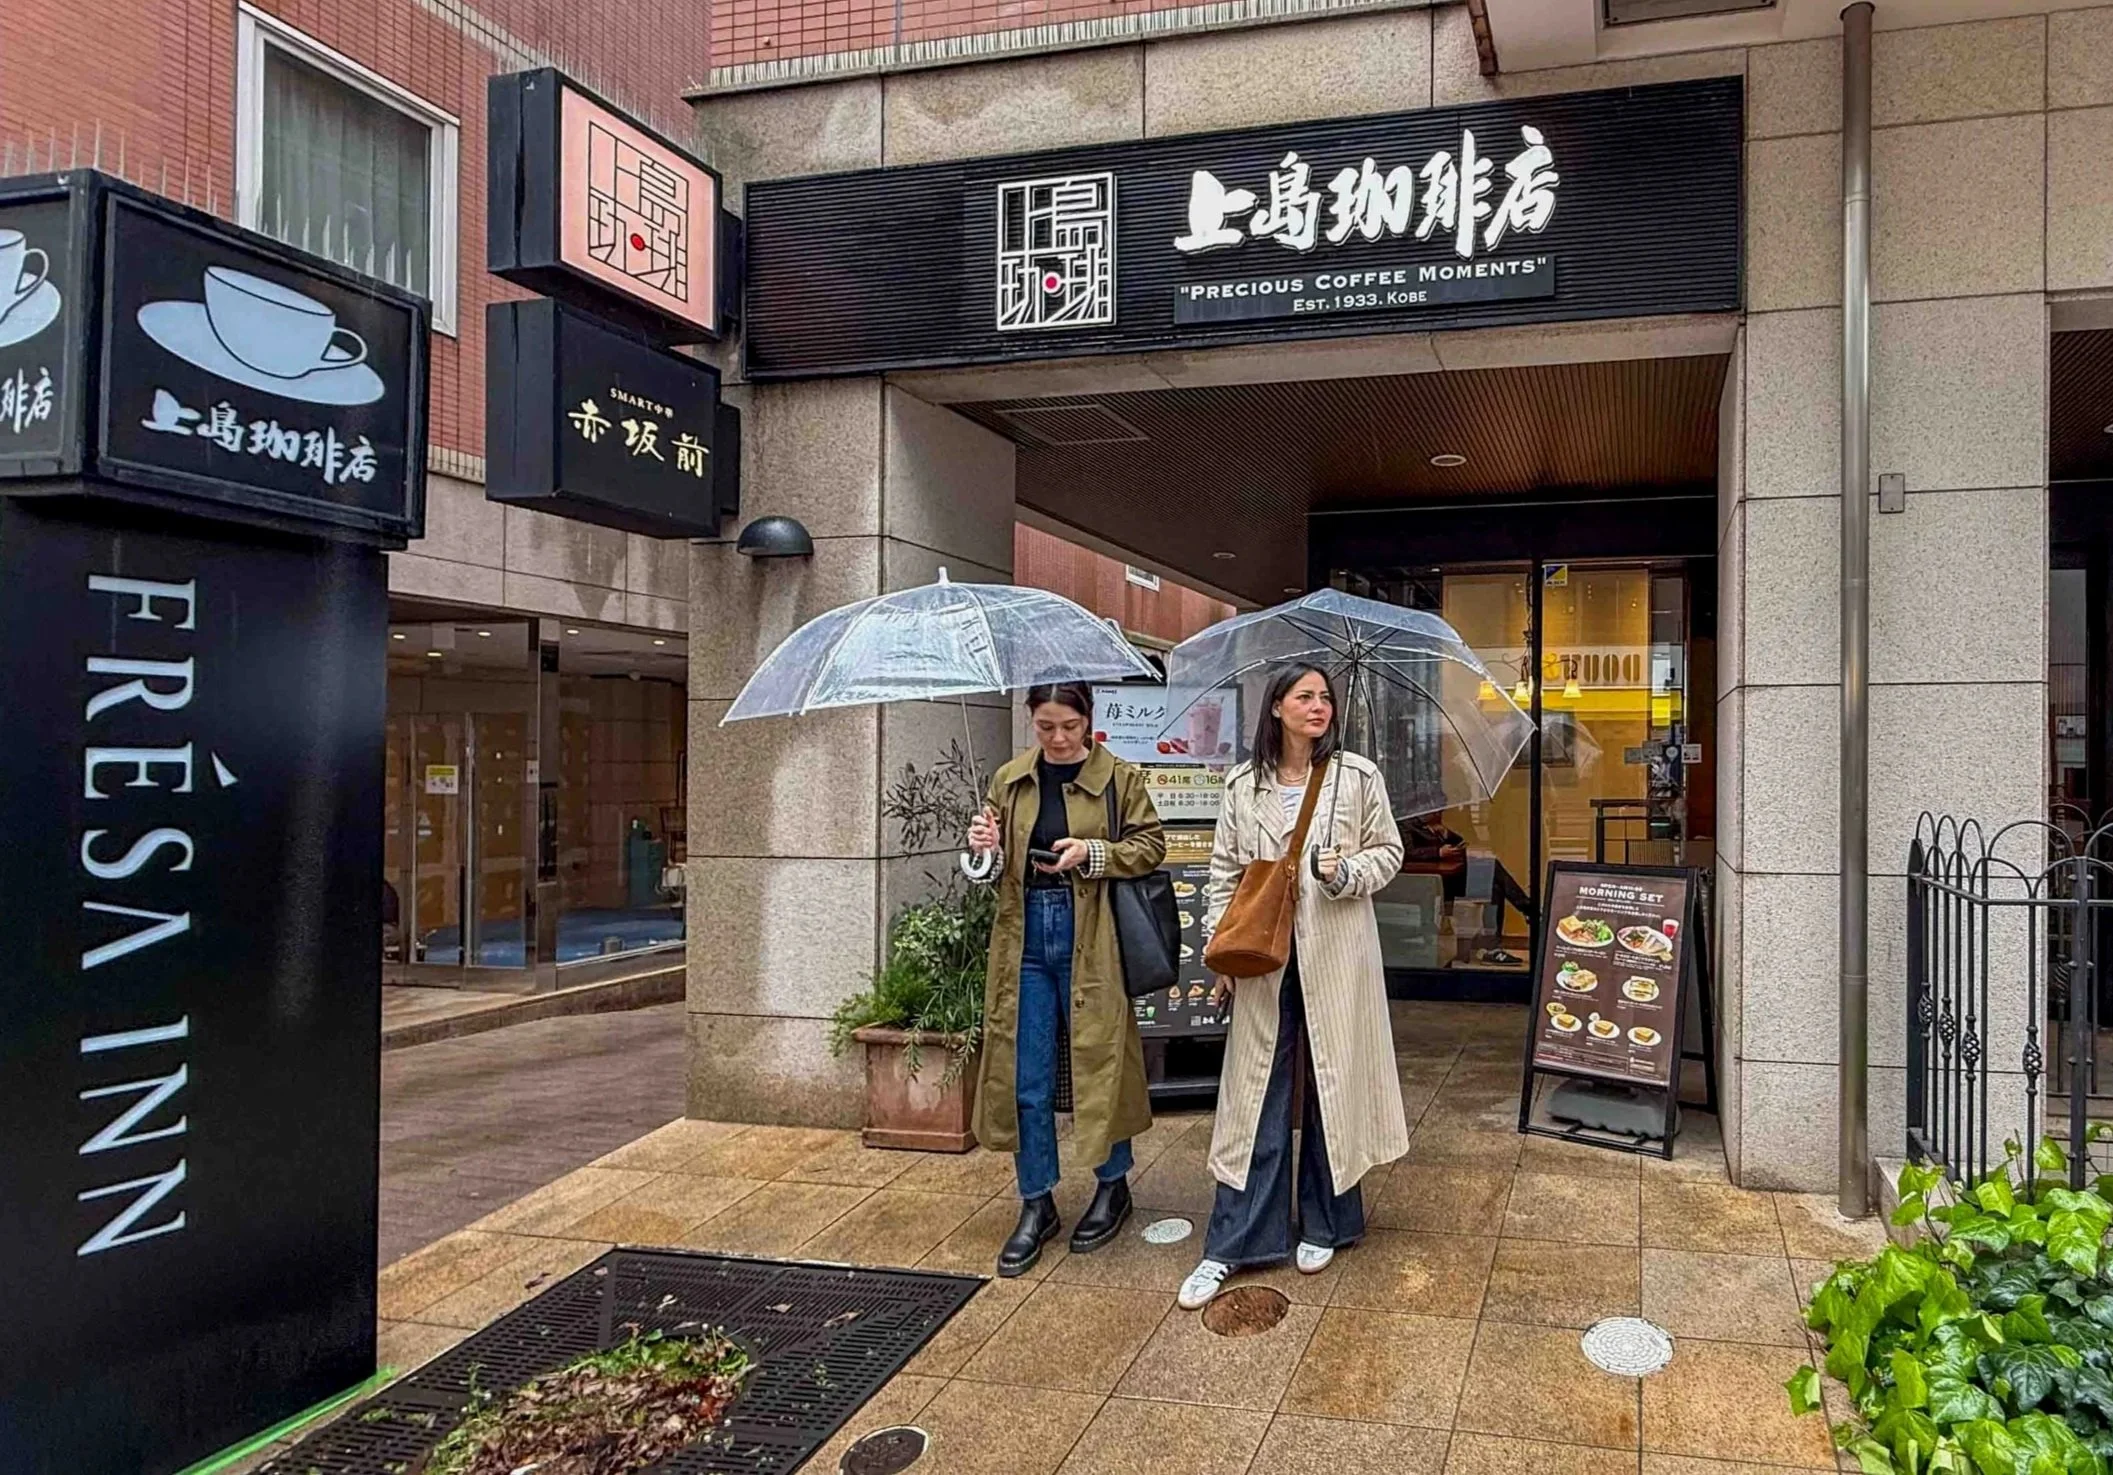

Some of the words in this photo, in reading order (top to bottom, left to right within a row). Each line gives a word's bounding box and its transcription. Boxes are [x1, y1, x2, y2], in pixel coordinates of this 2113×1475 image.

[1174, 125, 1560, 259] 上島珈琲店
[1180, 279, 1304, 301] "PRECIOUS
[1315, 270, 1407, 290] COFFEE
[1418, 257, 1547, 282] MOMENTS"
[141, 388, 379, 485] 上島珈琲店
[1106, 702, 1166, 720] 苺ミルク
[1578, 886, 1636, 900] MORNING
[1639, 892, 1664, 903] SET
[77, 1013, 190, 1257] INN
